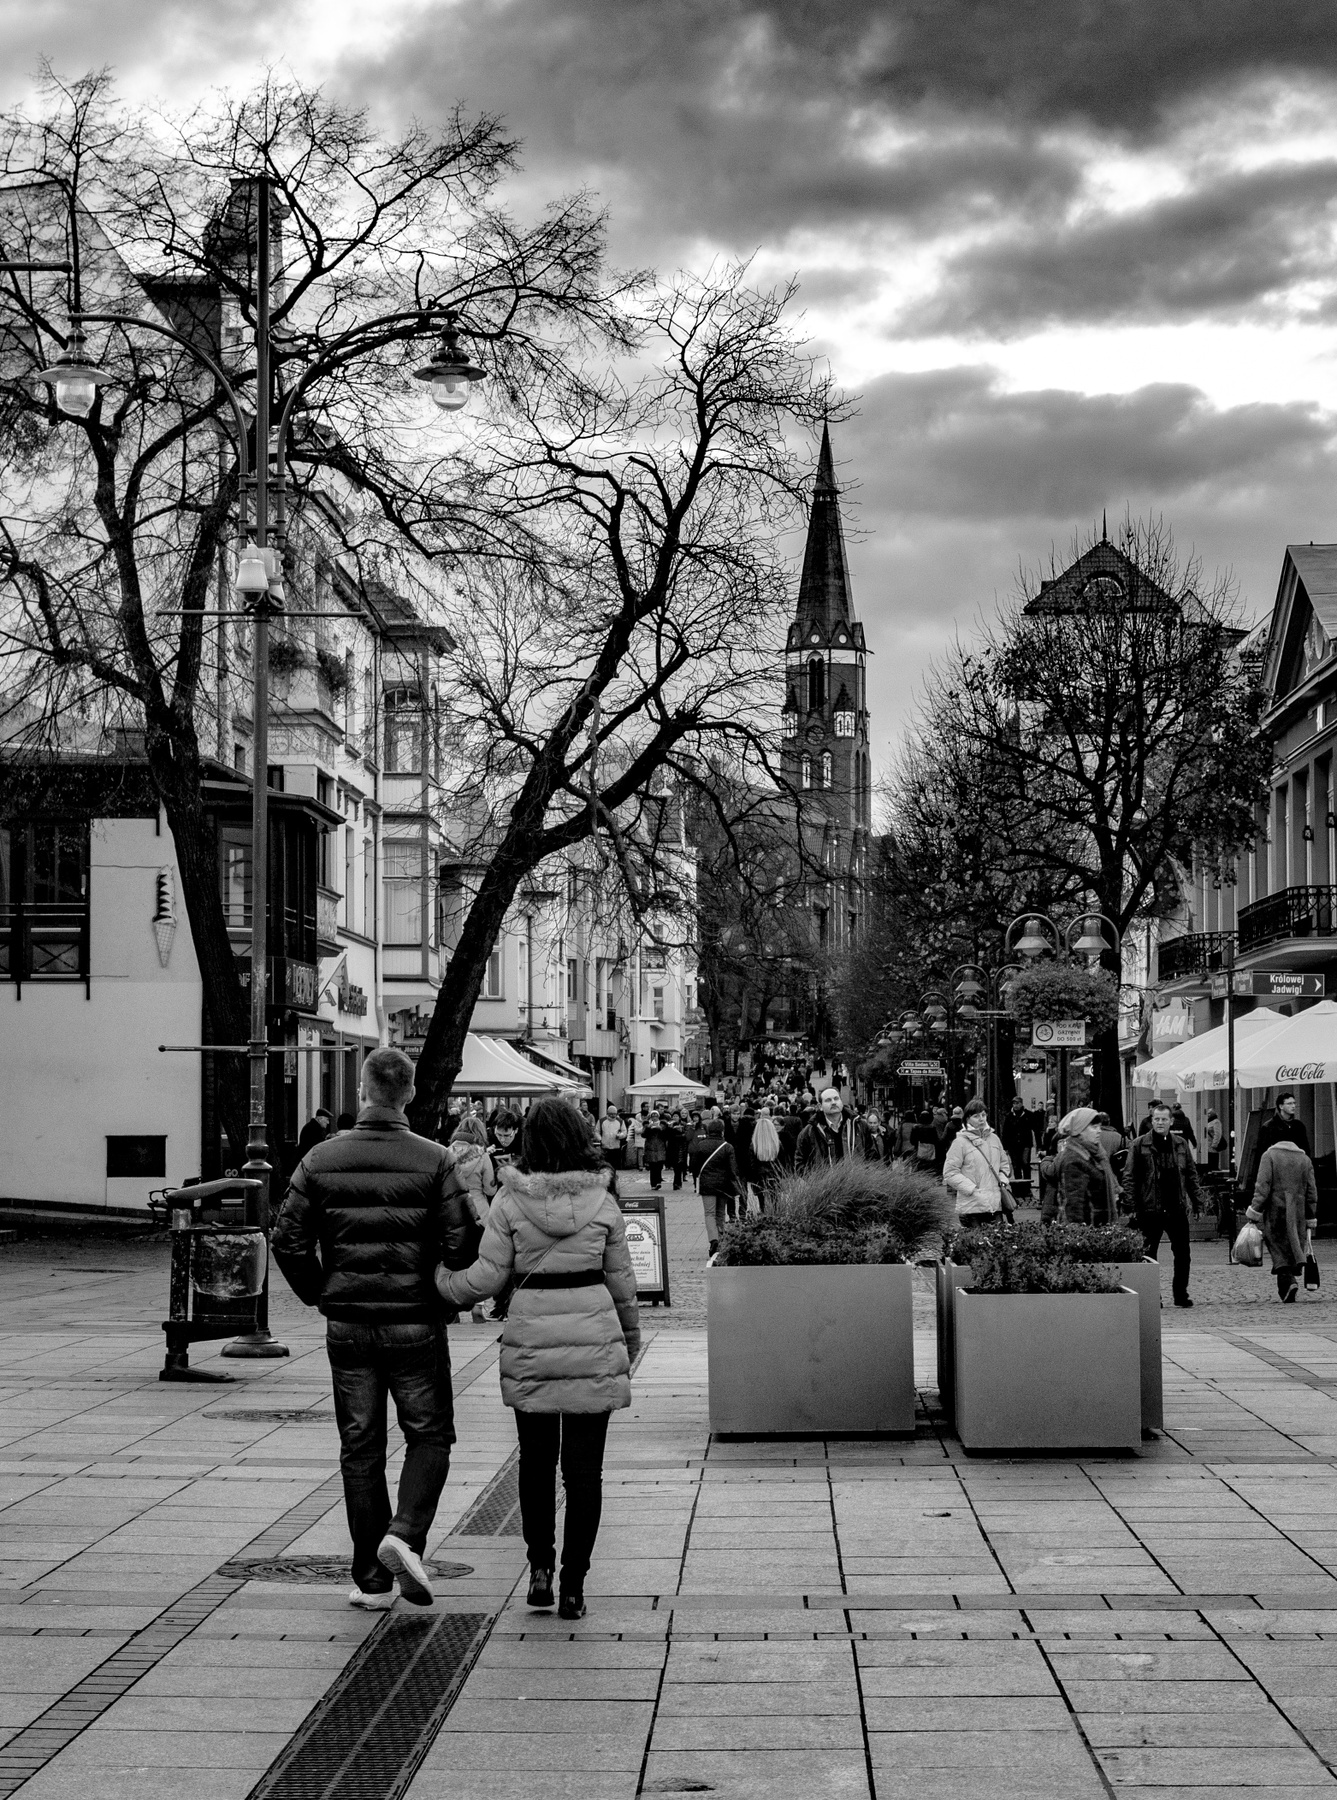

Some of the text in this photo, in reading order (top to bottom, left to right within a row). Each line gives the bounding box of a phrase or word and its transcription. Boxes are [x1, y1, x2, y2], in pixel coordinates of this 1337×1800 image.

[1269, 974, 1305, 986] Królowej
[1271, 985, 1302, 996] Jadwigi
[1155, 1015, 1187, 1036] H&M
[1275, 1061, 1326, 1083] Coca-Cola
